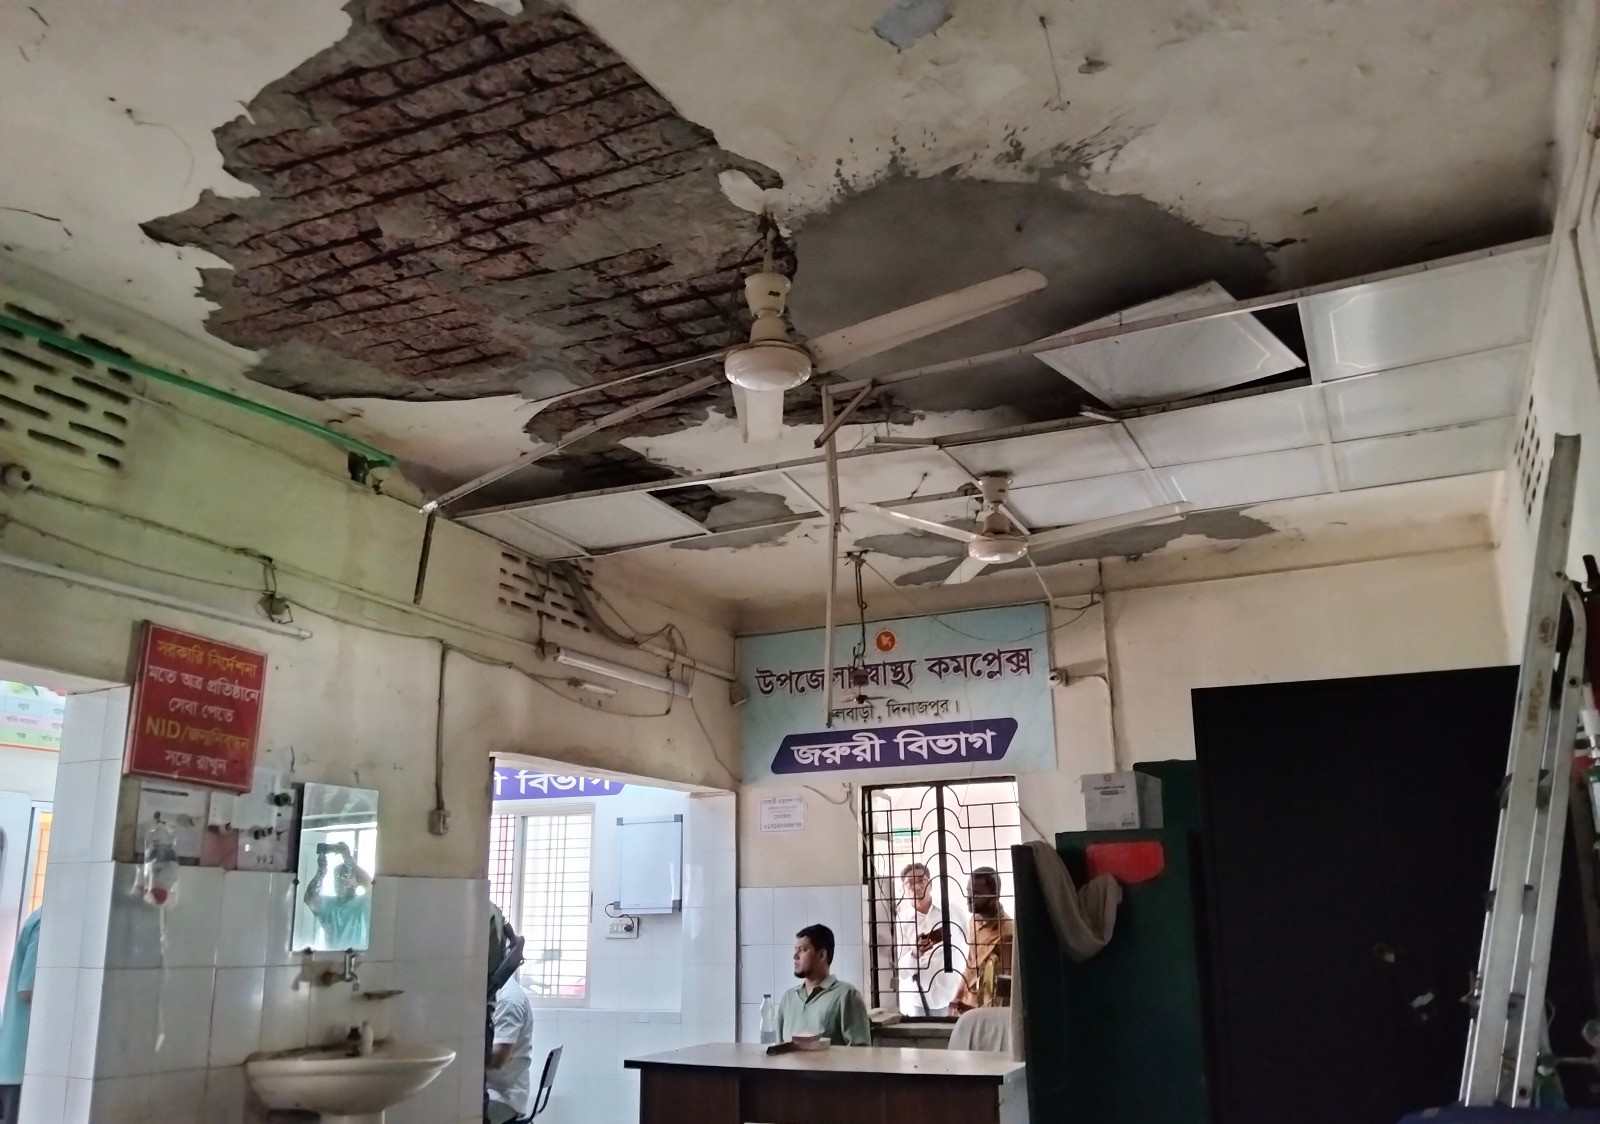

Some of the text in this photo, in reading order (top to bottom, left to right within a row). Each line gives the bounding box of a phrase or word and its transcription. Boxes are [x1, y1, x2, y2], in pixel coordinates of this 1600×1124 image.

[148, 664, 178, 684] মতে
[206, 676, 260, 703] প্রতিষ্ঠানে
[755, 665, 857, 695] উপজেলা
[925, 647, 1033, 680] কমপ্লেক্স
[169, 697, 235, 722] সেবা পেতে
[790, 728, 998, 766] জরুরী বিভাগ
